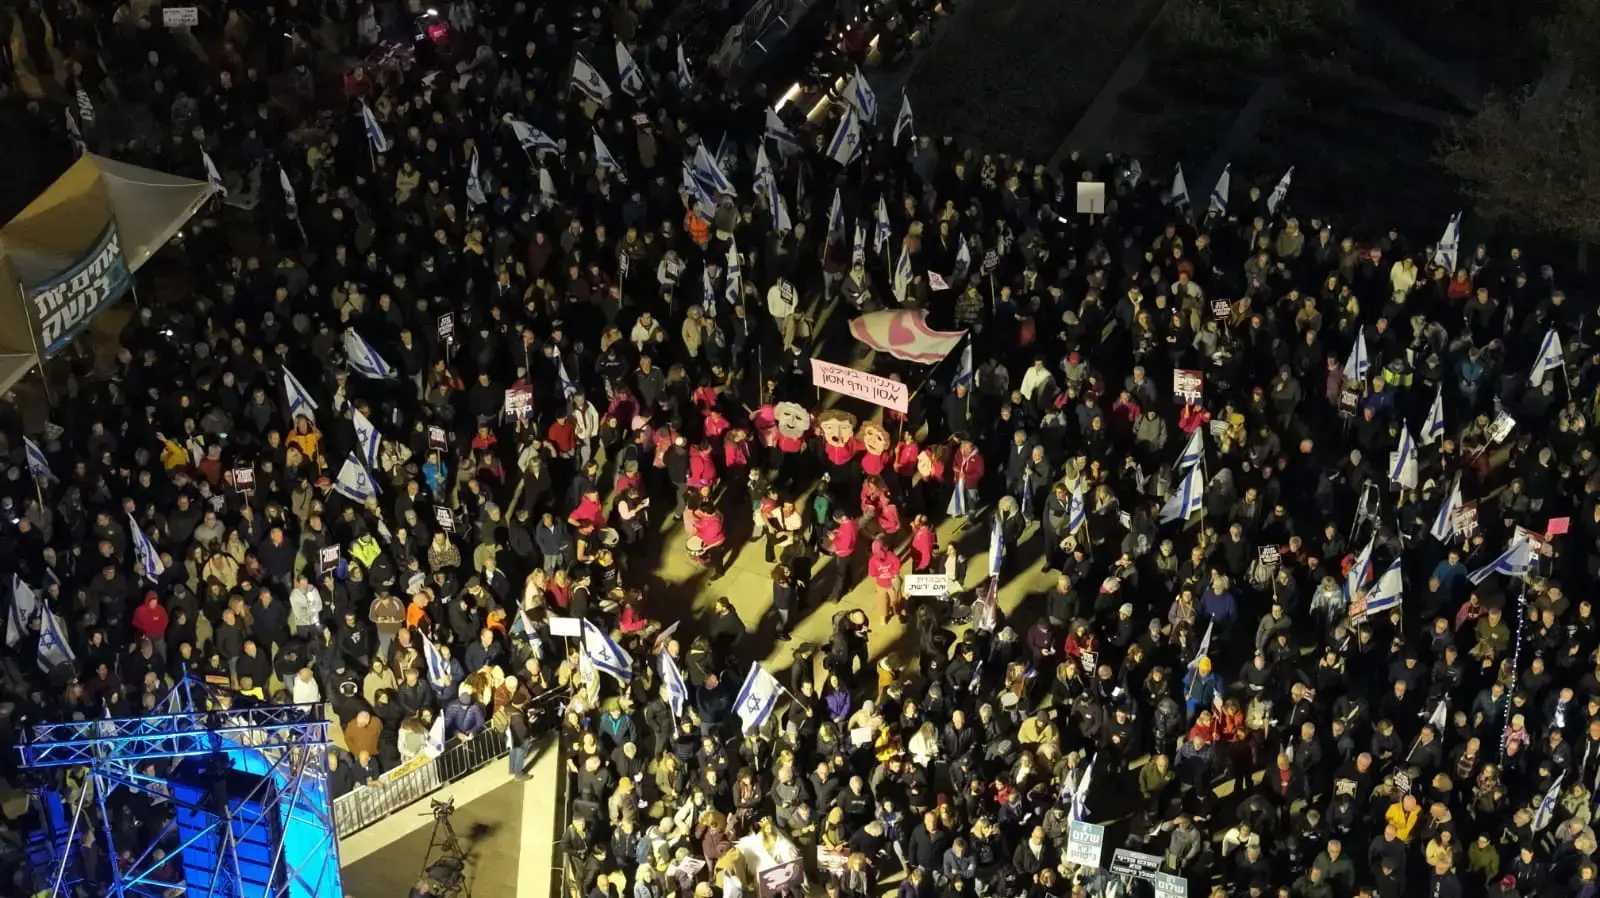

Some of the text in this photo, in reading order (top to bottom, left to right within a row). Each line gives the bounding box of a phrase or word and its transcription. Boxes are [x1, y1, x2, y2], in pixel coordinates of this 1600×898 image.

[42, 276, 111, 348] לנשק
[822, 373, 845, 387] אסון
[847, 380, 869, 393] רודף
[873, 387, 899, 404] אסון
[1072, 830, 1100, 844] שלום
[1158, 880, 1184, 894] שלום
